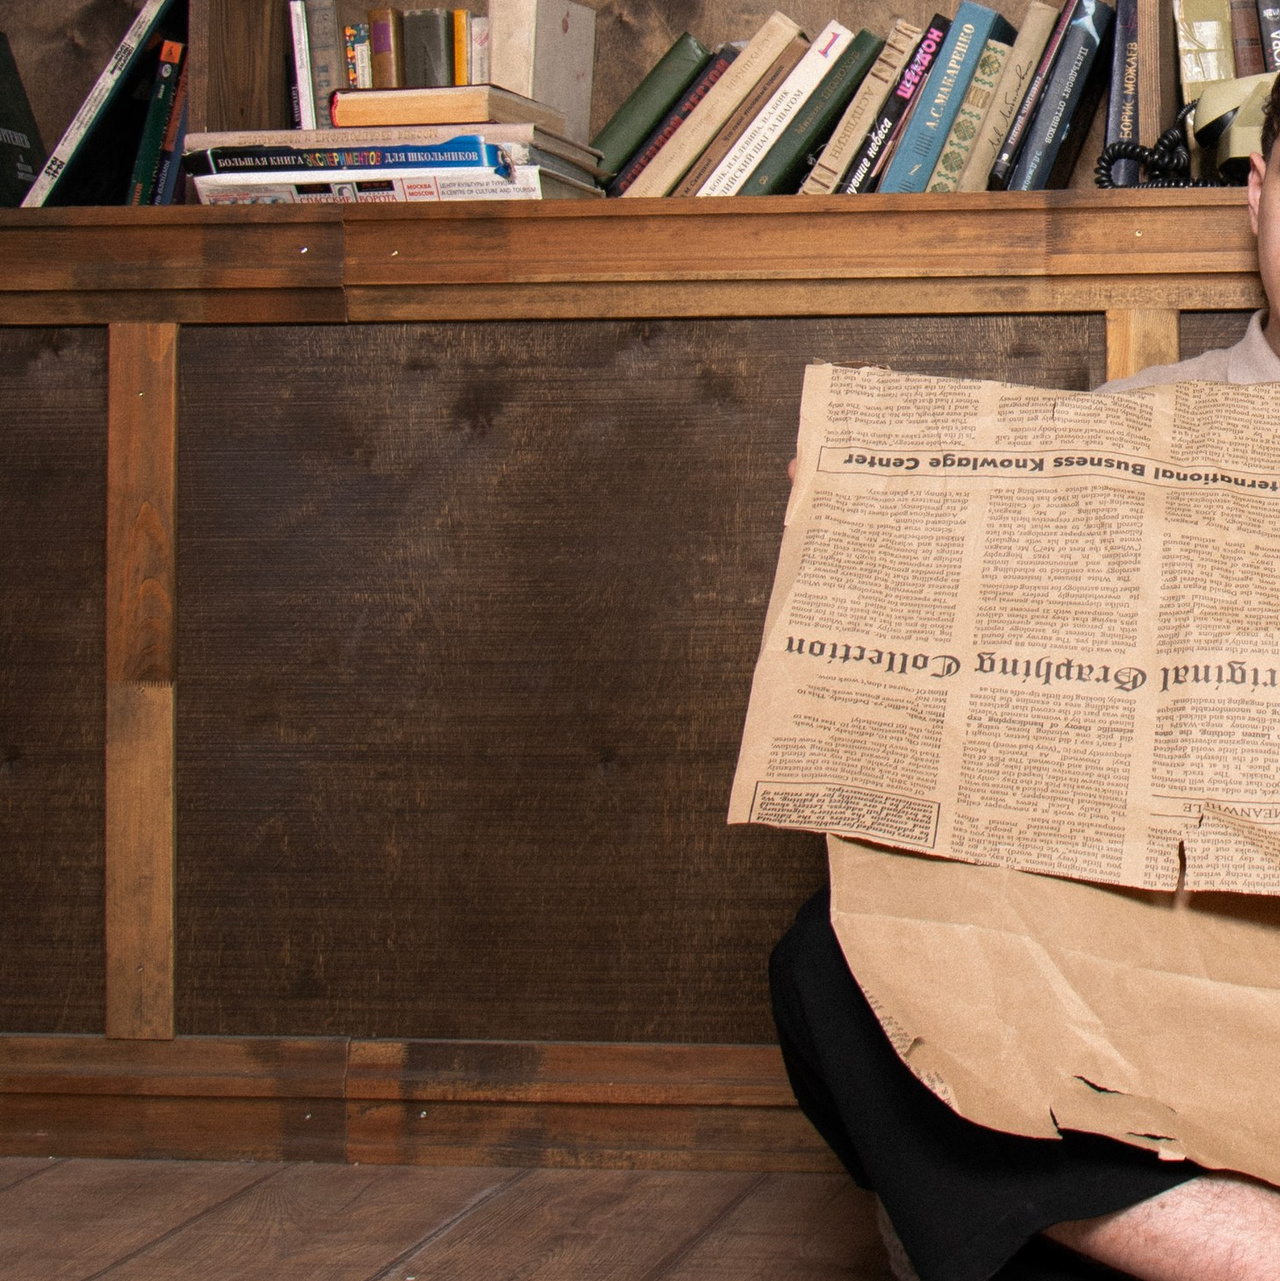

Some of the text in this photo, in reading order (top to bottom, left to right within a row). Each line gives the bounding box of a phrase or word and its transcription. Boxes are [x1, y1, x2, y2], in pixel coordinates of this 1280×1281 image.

[924, 24, 976, 125] А.С.МАКАРЕНКО
[1045, 46, 1089, 145] Пятьдесят оттенков
[1119, 40, 1141, 140] БОРИС МОЖАЕВ
[751, 134, 771, 154] ШАГ
[774, 89, 802, 122] ШАГОМ
[864, 117, 895, 157] небеса
[217, 149, 477, 168] БОЛЬШАЯ КНИГА ЭКСПЕРИМЕНТОВ ДЛЯ ШКОЛЬНИКОВ
[843, 452, 921, 470] Center
[928, 453, 1045, 473] Knowlage
[1054, 455, 1146, 477] Busness
[783, 634, 1147, 695] Graphing Collection
